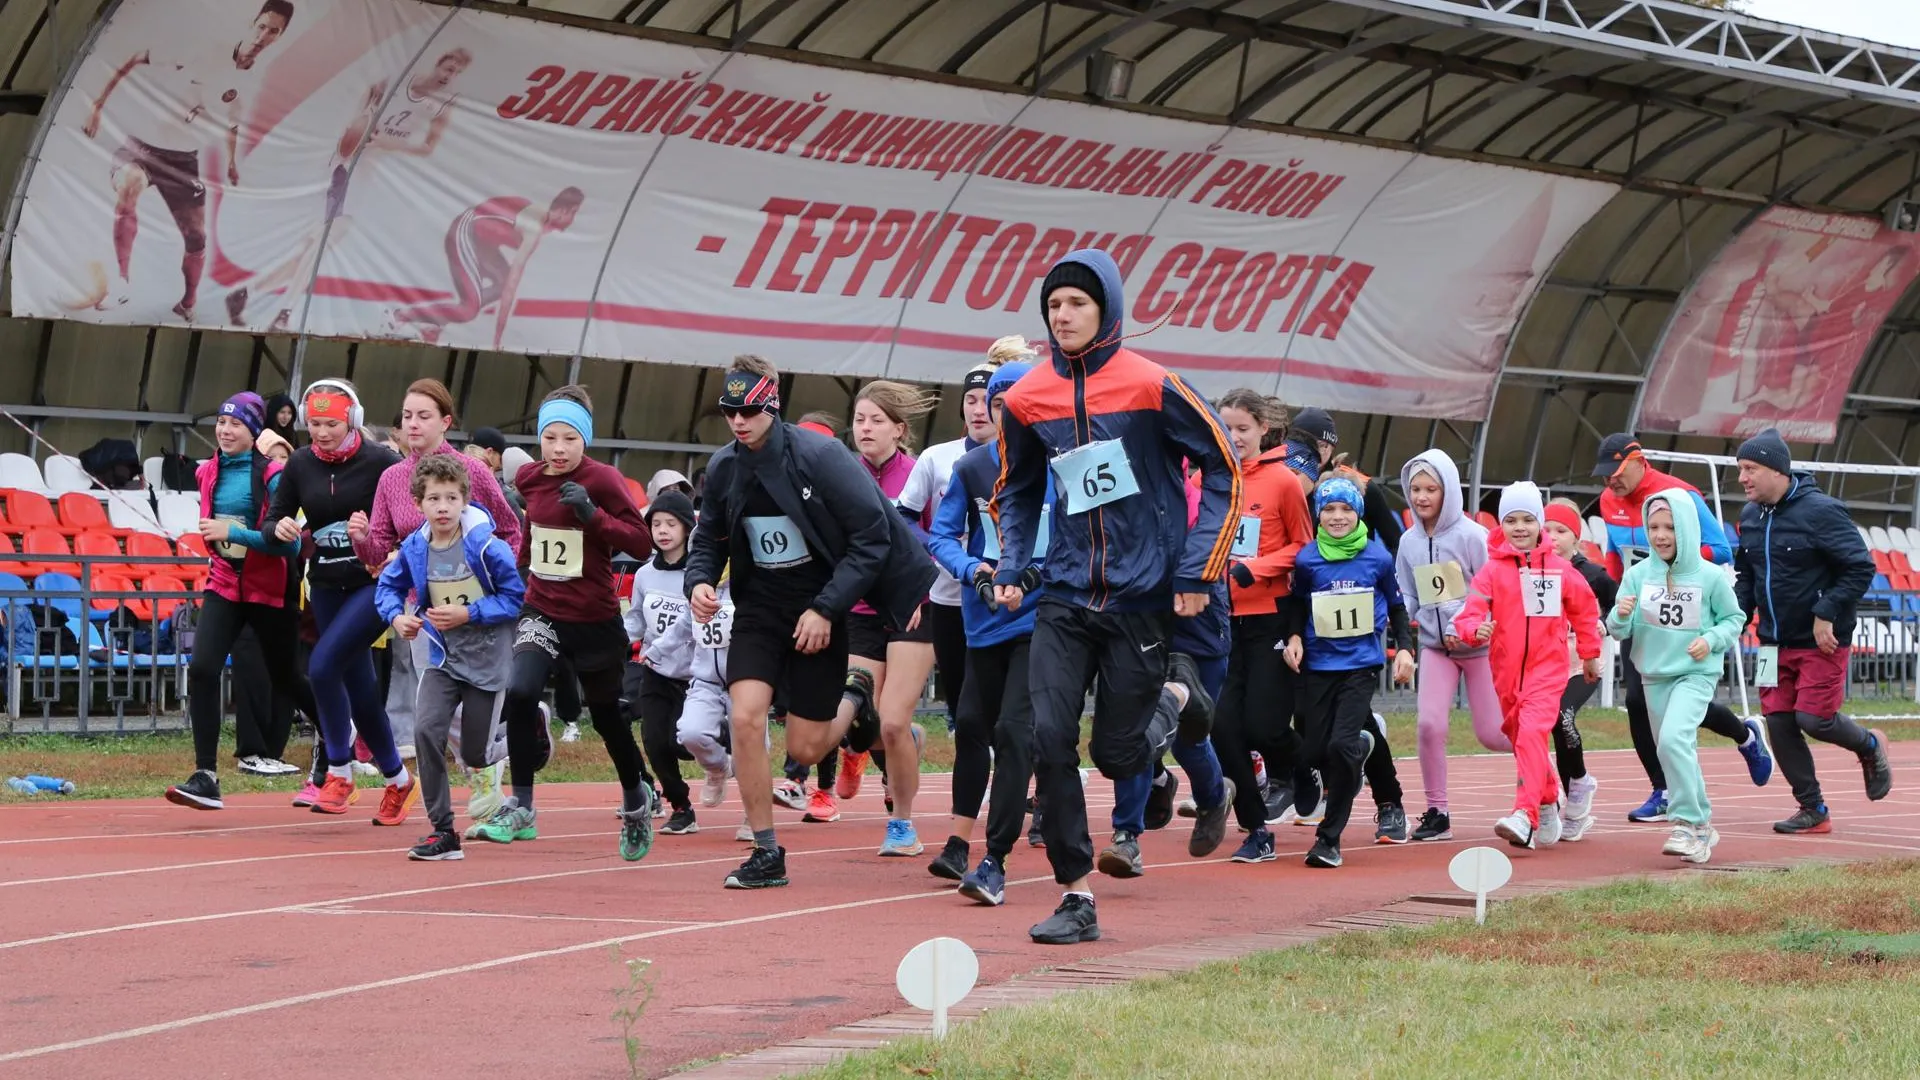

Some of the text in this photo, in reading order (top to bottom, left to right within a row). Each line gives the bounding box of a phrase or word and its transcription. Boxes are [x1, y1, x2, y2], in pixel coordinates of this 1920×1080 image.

[497, 65, 1346, 219] ЗАРАЙСКИЙ МУНИЦИПАЛЬНЫЙ РАЙОН
[733, 197, 1155, 313] ТЕРРИТОРЯ
[1132, 242, 1375, 340] СПОРТА
[1083, 462, 1117, 498] 65
[540, 540, 567, 565] 12
[760, 530, 788, 555] 69
[1432, 576, 1445, 596] 9
[1333, 608, 1360, 631] 11
[1659, 603, 1684, 626] 53
[702, 622, 723, 645] 35
